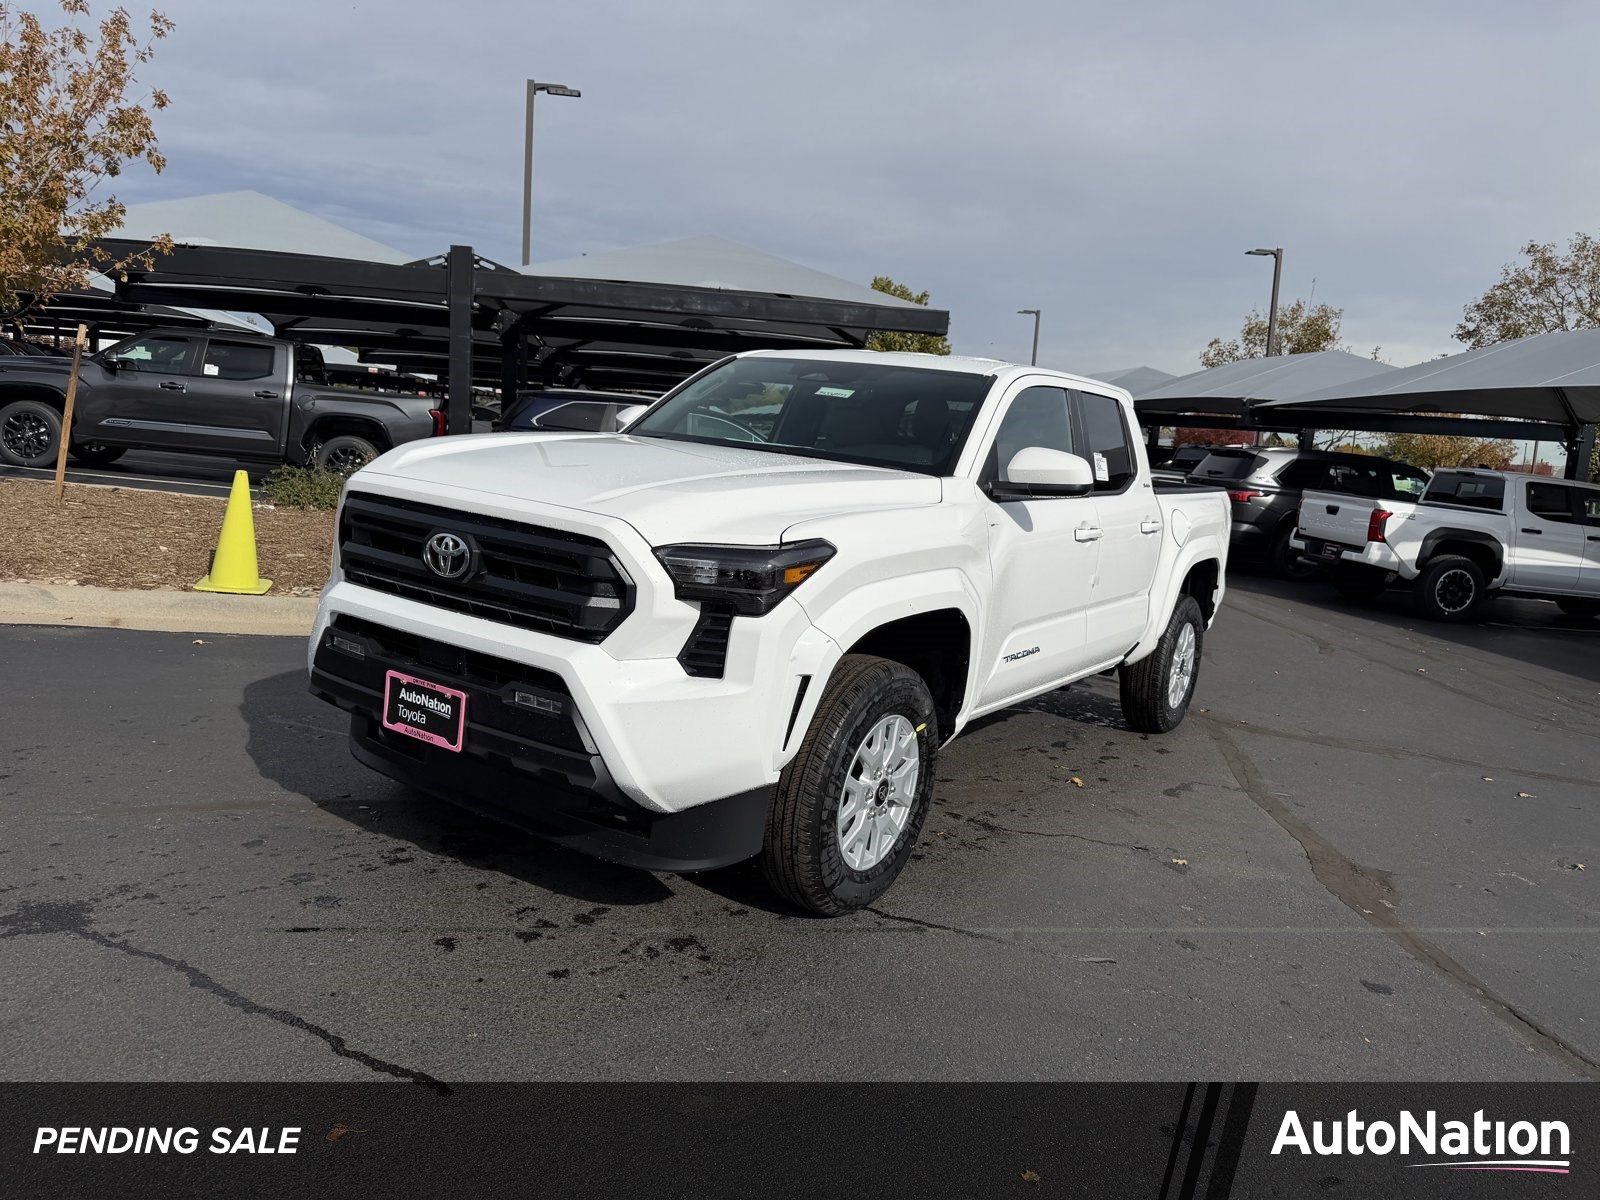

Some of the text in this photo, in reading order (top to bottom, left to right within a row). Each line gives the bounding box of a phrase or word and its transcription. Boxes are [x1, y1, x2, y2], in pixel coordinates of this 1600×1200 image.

[1002, 646, 1041, 663] TACOMA
[399, 688, 452, 715] AutoNation
[397, 703, 427, 724] Toyota
[403, 727, 434, 742] AutoNation
